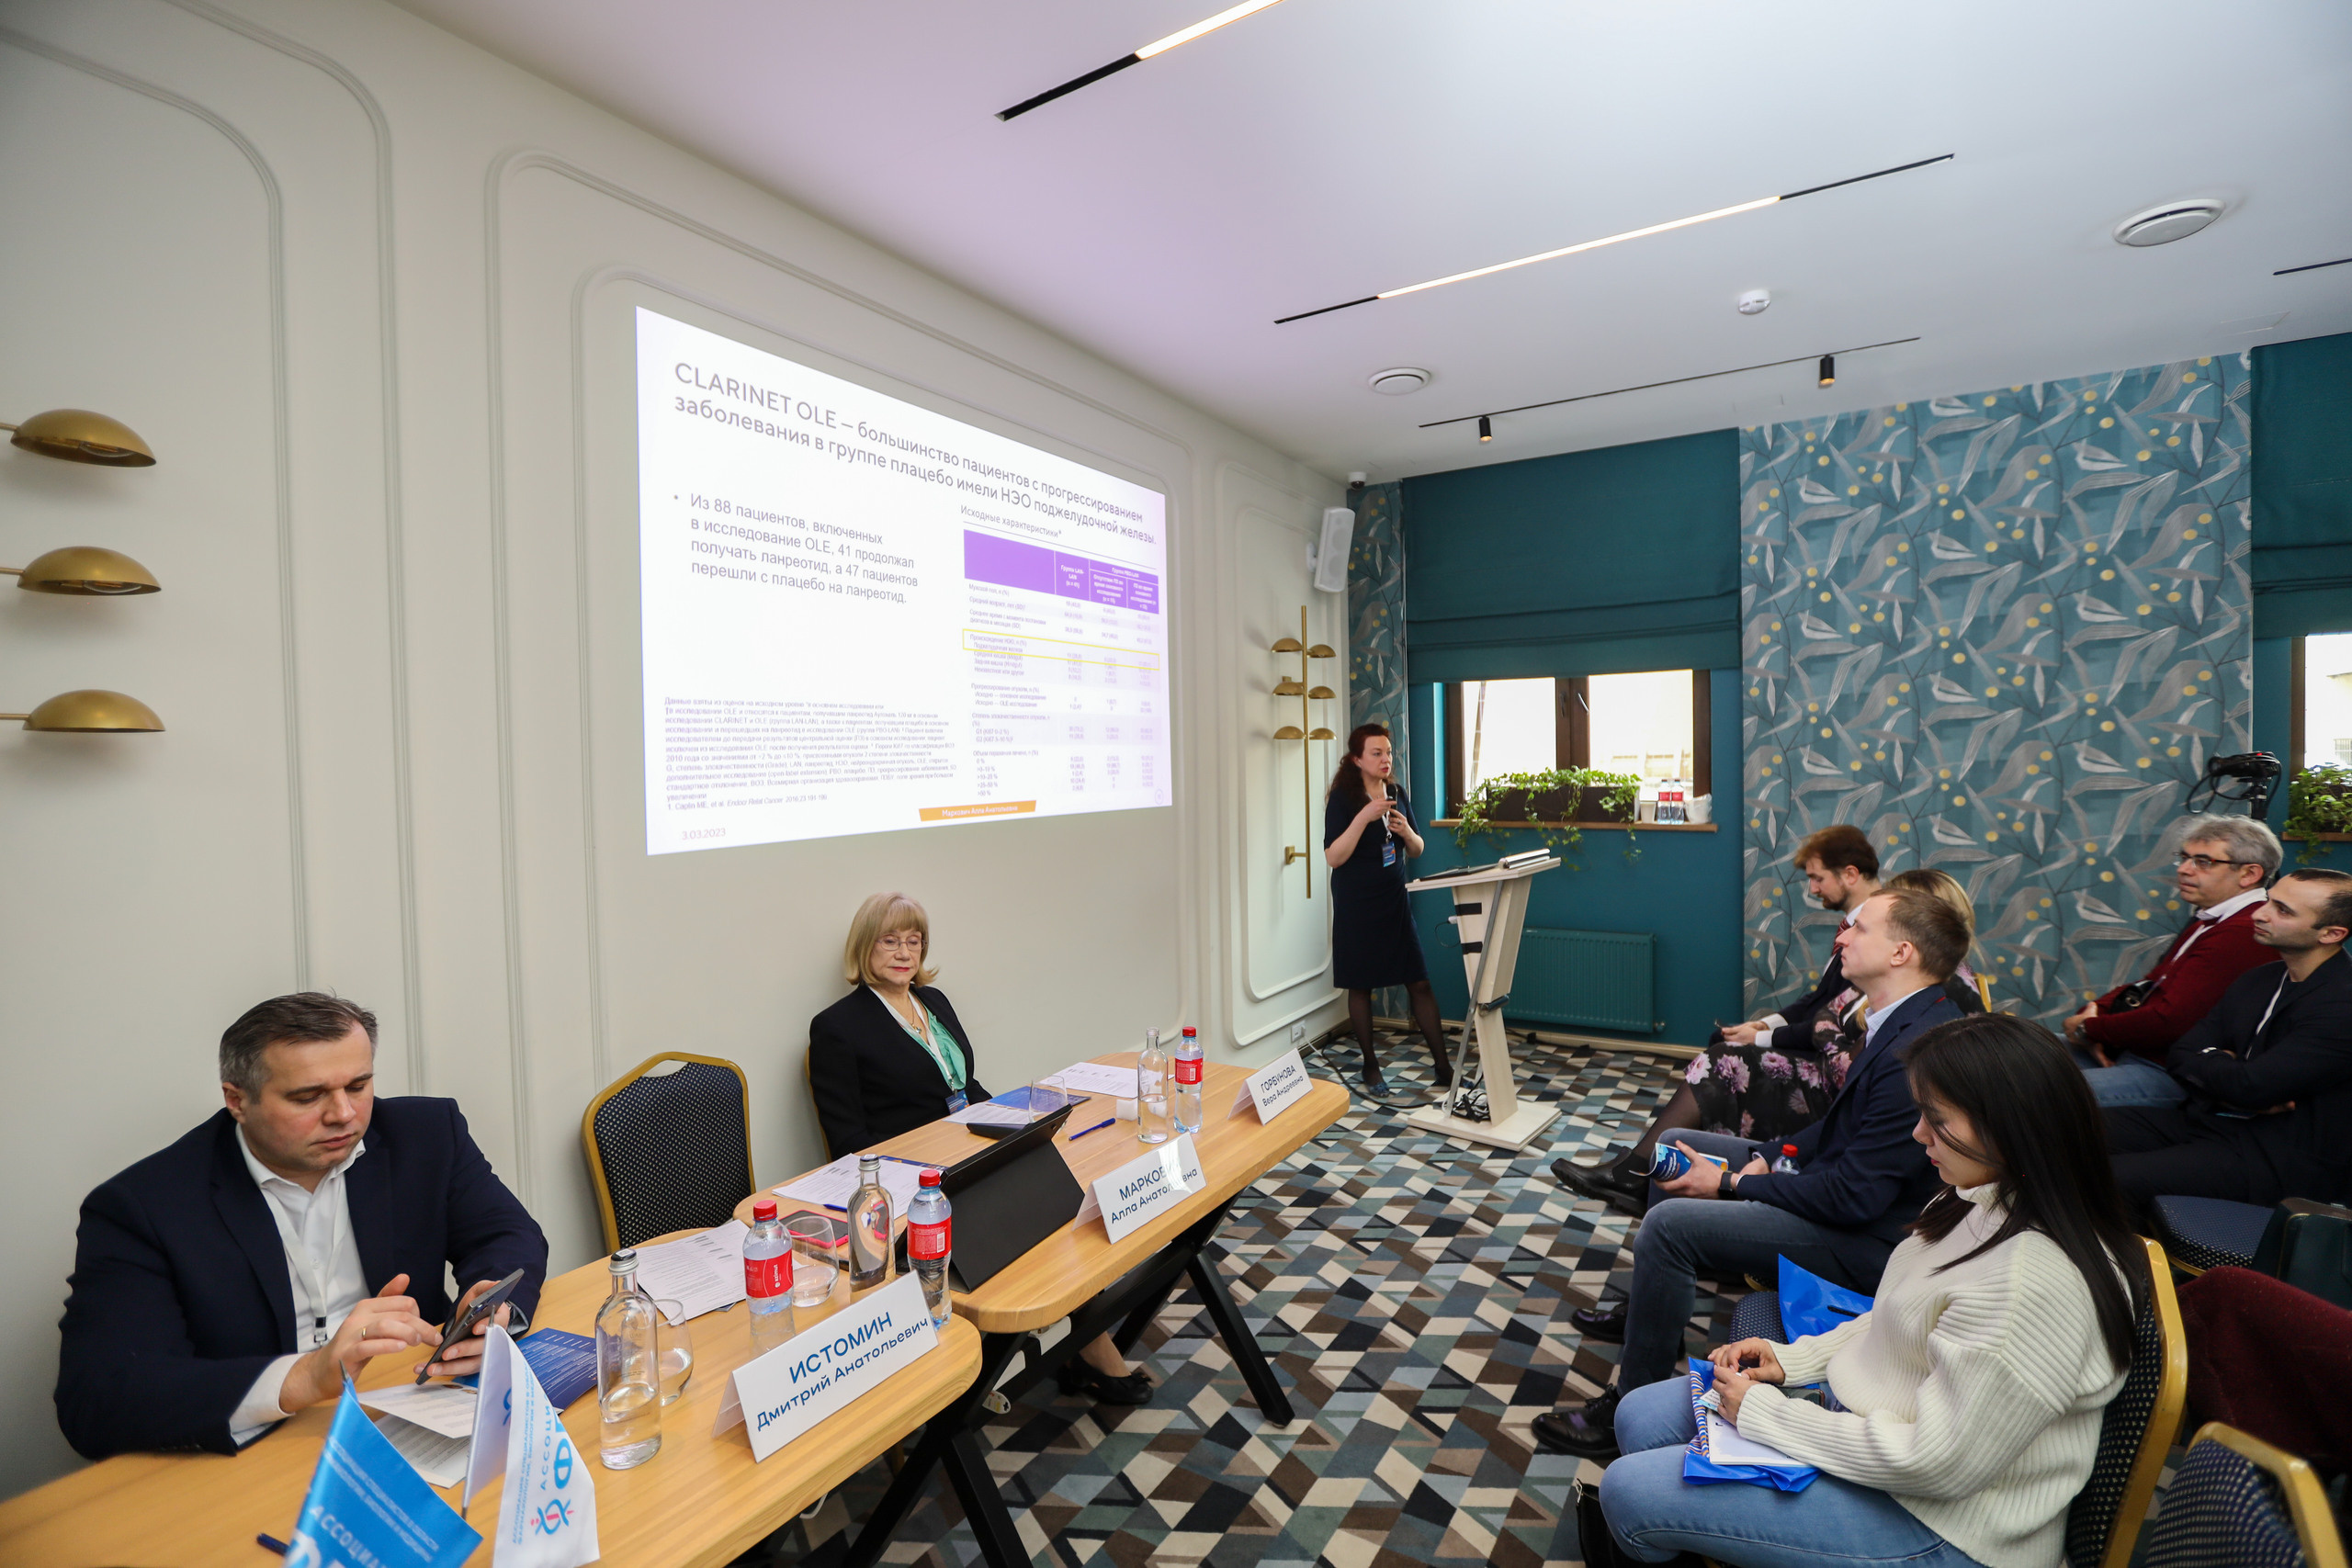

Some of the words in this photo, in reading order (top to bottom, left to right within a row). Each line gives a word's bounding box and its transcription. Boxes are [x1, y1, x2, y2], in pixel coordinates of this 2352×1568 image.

[674, 362, 792, 415] CLARINET
[796, 400, 837, 430] OLE
[857, 421, 960, 467] большинство
[962, 457, 1030, 489] пациентов
[1032, 479, 1039, 491] с
[1041, 481, 1143, 523] прогрессированием
[674, 396, 810, 447] заболевания
[815, 436, 824, 451] в
[829, 440, 887, 468] группе
[890, 458, 954, 487] плацебо
[956, 478, 998, 501] имели
[1001, 486, 1032, 509] НЭО
[1034, 500, 1118, 535] поджелудочной
[1119, 525, 1157, 545] железы.
[690, 492, 710, 511] Из
[714, 498, 731, 514] 88
[736, 505, 809, 532] пациентов,
[812, 521, 883, 545] включенных
[960, 504, 1001, 524] Исходные
[691, 518, 699, 530] в
[704, 521, 801, 548] исследование
[804, 536, 834, 556] OLE,
[837, 543, 851, 558] 41
[854, 548, 914, 570] продолжал
[691, 539, 757, 561] получать
[761, 551, 831, 575] ланреотид,
[835, 564, 842, 575] а
[845, 563, 859, 577] 47
[862, 569, 919, 587] пациентов
[691, 561, 757, 581] перешли
[760, 572, 769, 583] с
[772, 573, 826, 592] плацебо
[829, 582, 842, 594] на
[845, 585, 907, 604] ланреотид.
[663, 696, 692, 706] Данные
[665, 753, 684, 763] 2010
[1261, 1065, 1296, 1094] ГОРБУНОВА
[1262, 1094, 1277, 1107] Вера
[1111, 1202, 1137, 1224] Алла
[788, 1311, 893, 1384] ИСТОМИН
[757, 1374, 831, 1432] Дмитрий
[834, 1317, 929, 1382] Анатольевич
